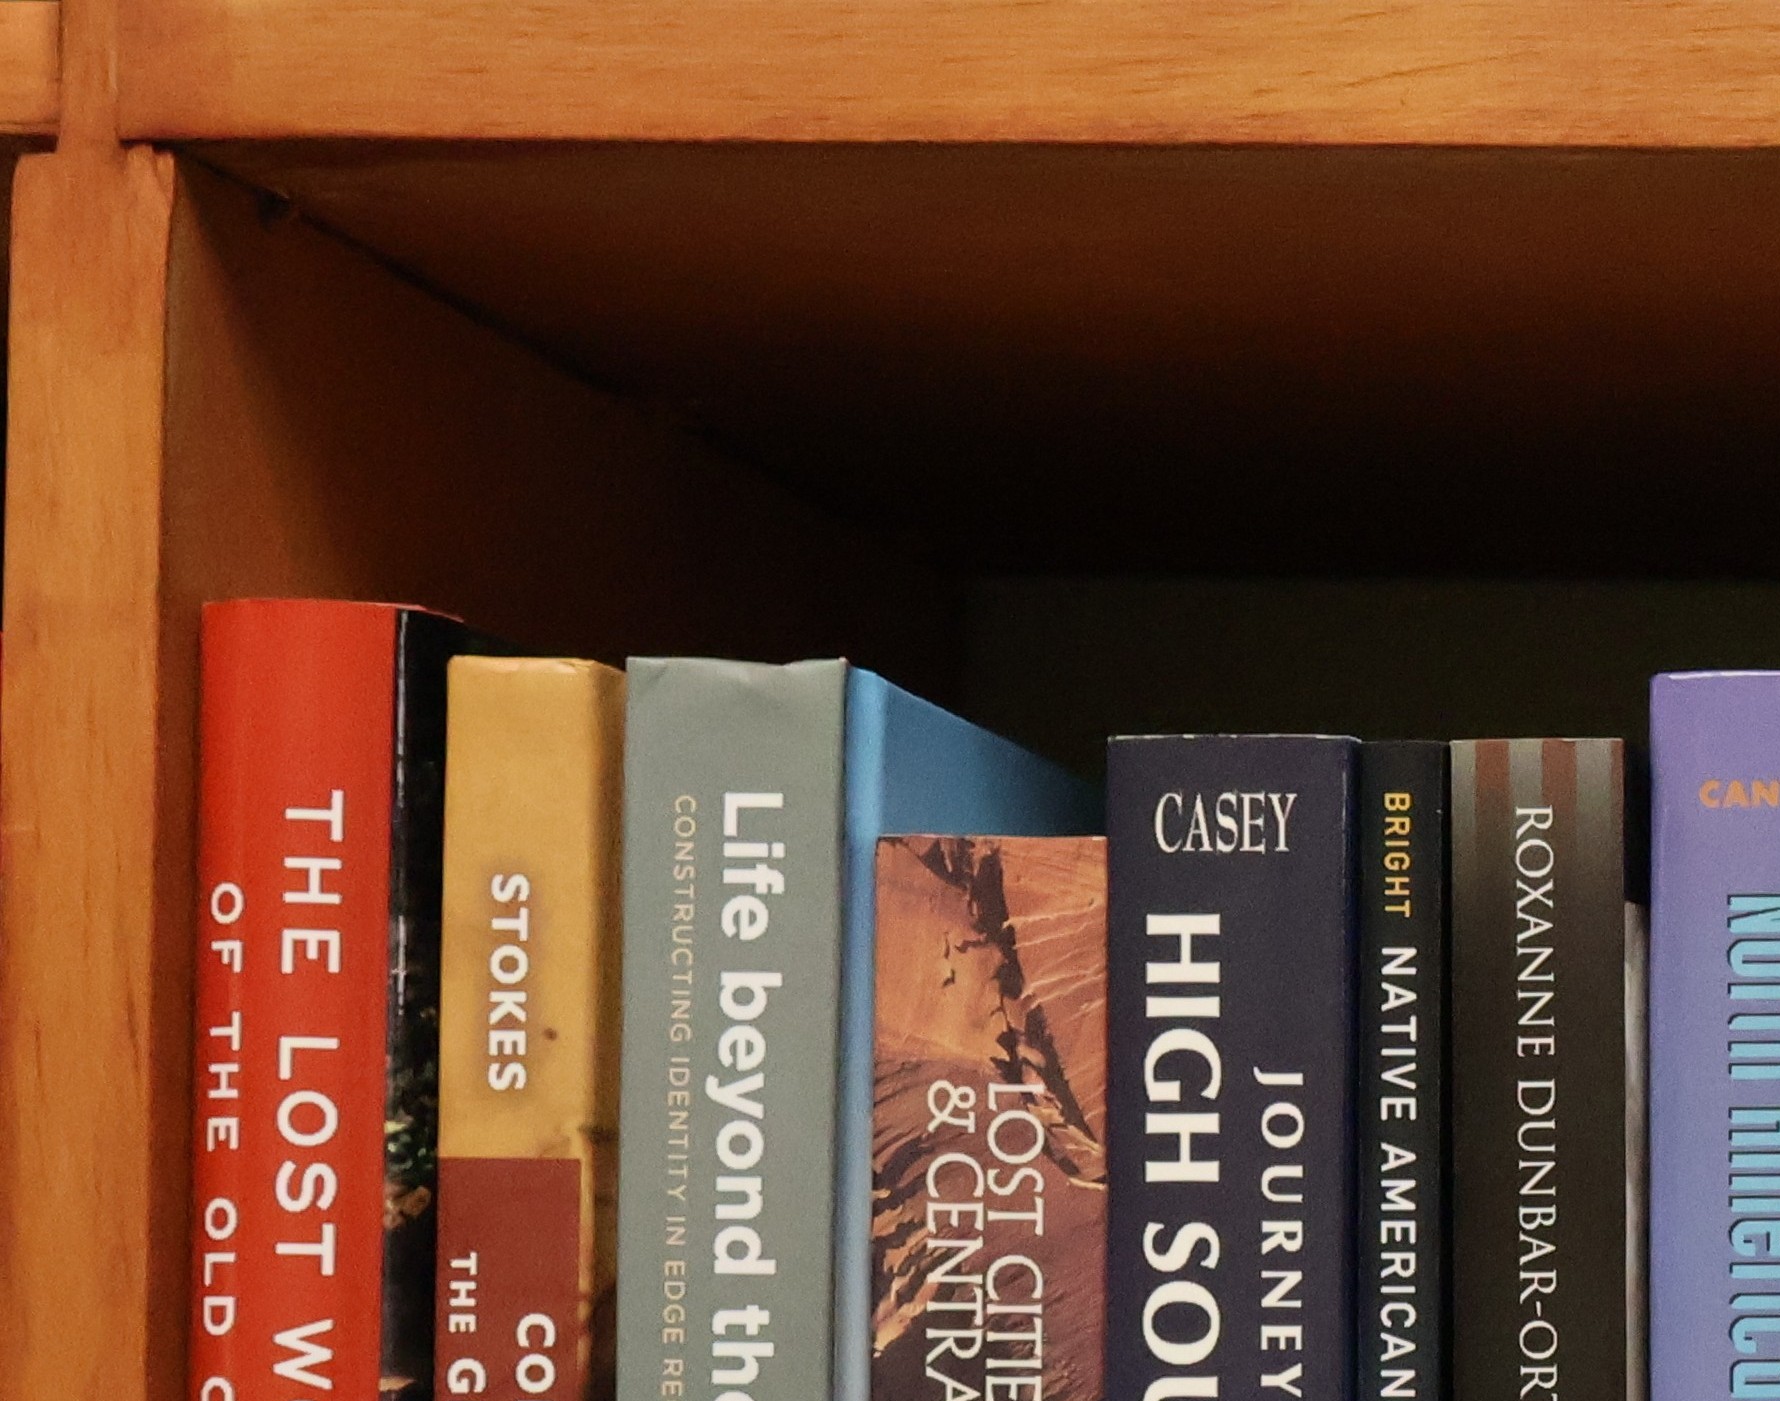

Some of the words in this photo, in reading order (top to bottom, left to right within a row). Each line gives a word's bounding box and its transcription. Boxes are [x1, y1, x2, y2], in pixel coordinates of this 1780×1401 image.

[282, 790, 343, 973] THE
[722, 792, 785, 940] Life
[1155, 791, 1297, 854] CASEY
[1384, 793, 1410, 917] BRIGHT
[488, 875, 529, 1090] STOKES
[670, 795, 696, 1041] CONSTRUCTING
[1515, 805, 1554, 1056] ROXANNE
[706, 972, 782, 1274] beyond
[1145, 914, 1221, 1182] HIGH
[1381, 948, 1417, 1120] NATIVE
[276, 1036, 339, 1275] LOST
[667, 1057, 690, 1201] IDENTITY
[660, 1261, 689, 1345] EDGE
[665, 1215, 688, 1247] IN
[1380, 1143, 1416, 1397] AMERICAN
